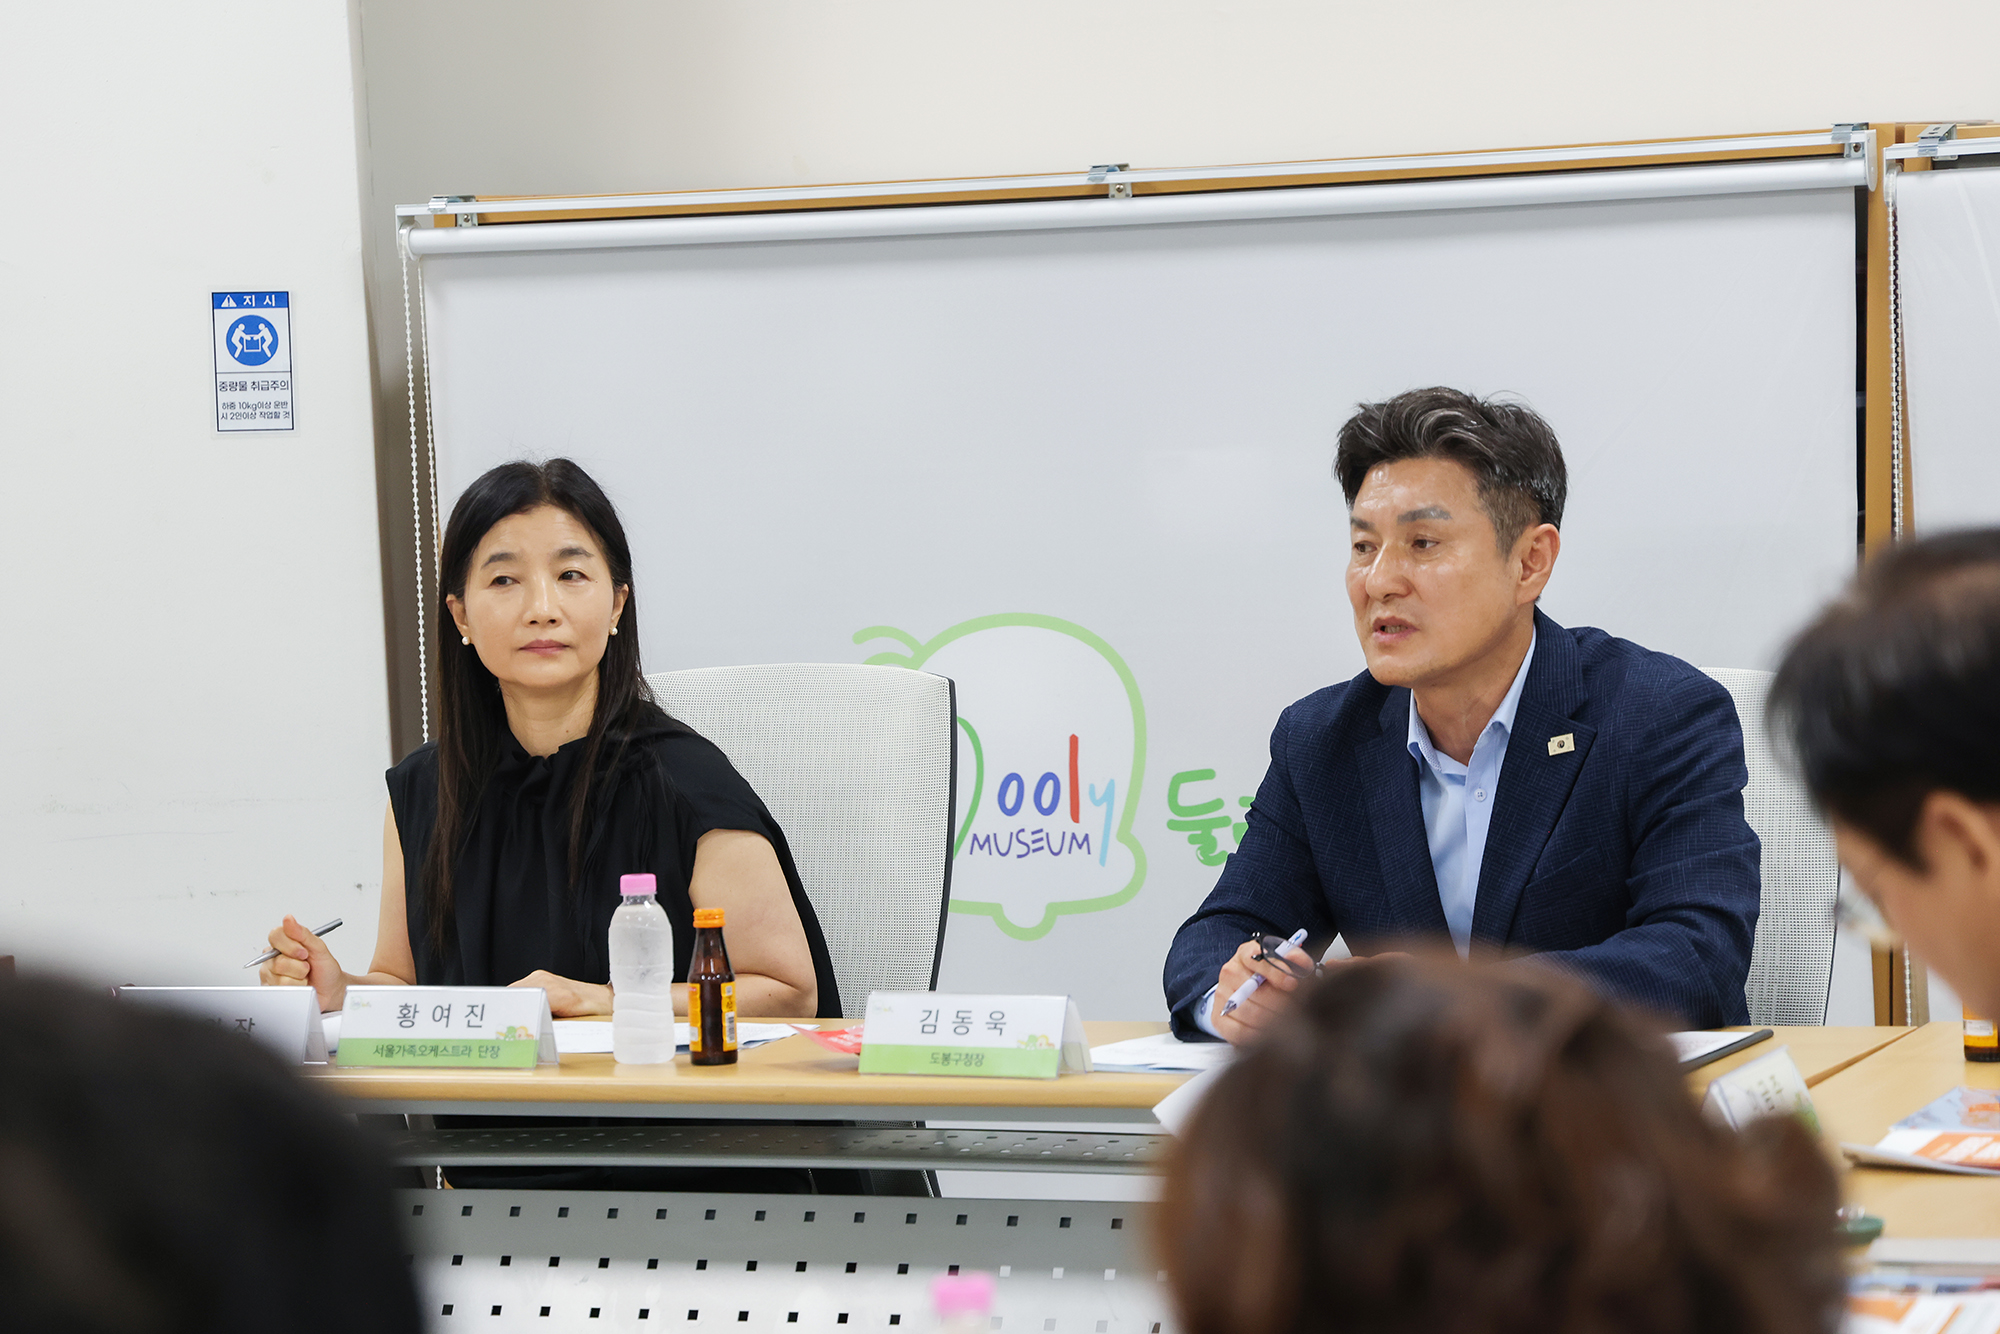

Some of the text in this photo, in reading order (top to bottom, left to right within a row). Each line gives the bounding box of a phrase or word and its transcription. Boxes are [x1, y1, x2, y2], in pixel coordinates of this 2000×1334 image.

[219, 380, 289, 392] 중량물 취급주의
[222, 401, 289, 411] 하중 10kg이상 운반
[220, 411, 291, 420] 시 2인이상 작업할 것
[1166, 768, 1256, 867] 둘
[969, 827, 1092, 860] MUSEUM
[373, 1044, 501, 1059] 서울가족오케스트라 단장
[929, 1051, 986, 1067] 도봉구청장
